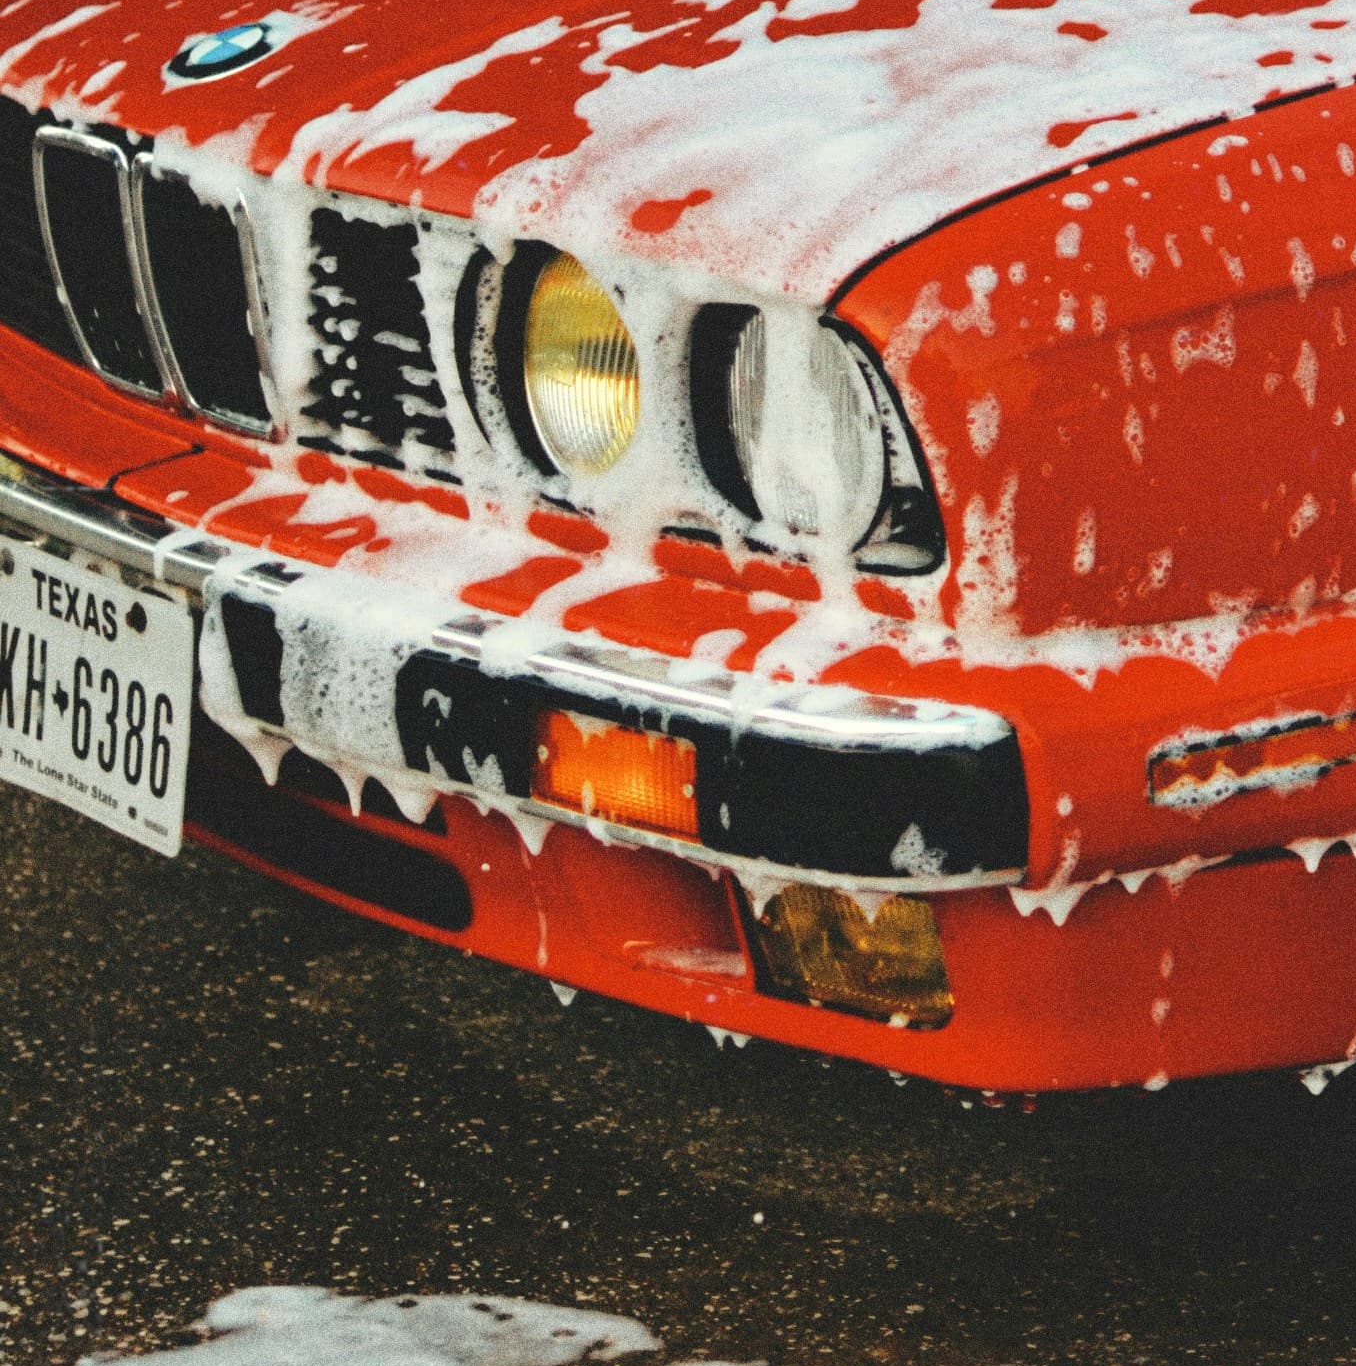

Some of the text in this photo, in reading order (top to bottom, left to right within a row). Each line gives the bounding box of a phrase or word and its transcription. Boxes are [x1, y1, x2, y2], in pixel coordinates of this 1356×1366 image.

[31, 568, 118, 642] TEXAS
[12, 748, 119, 810] The Lone Star State
